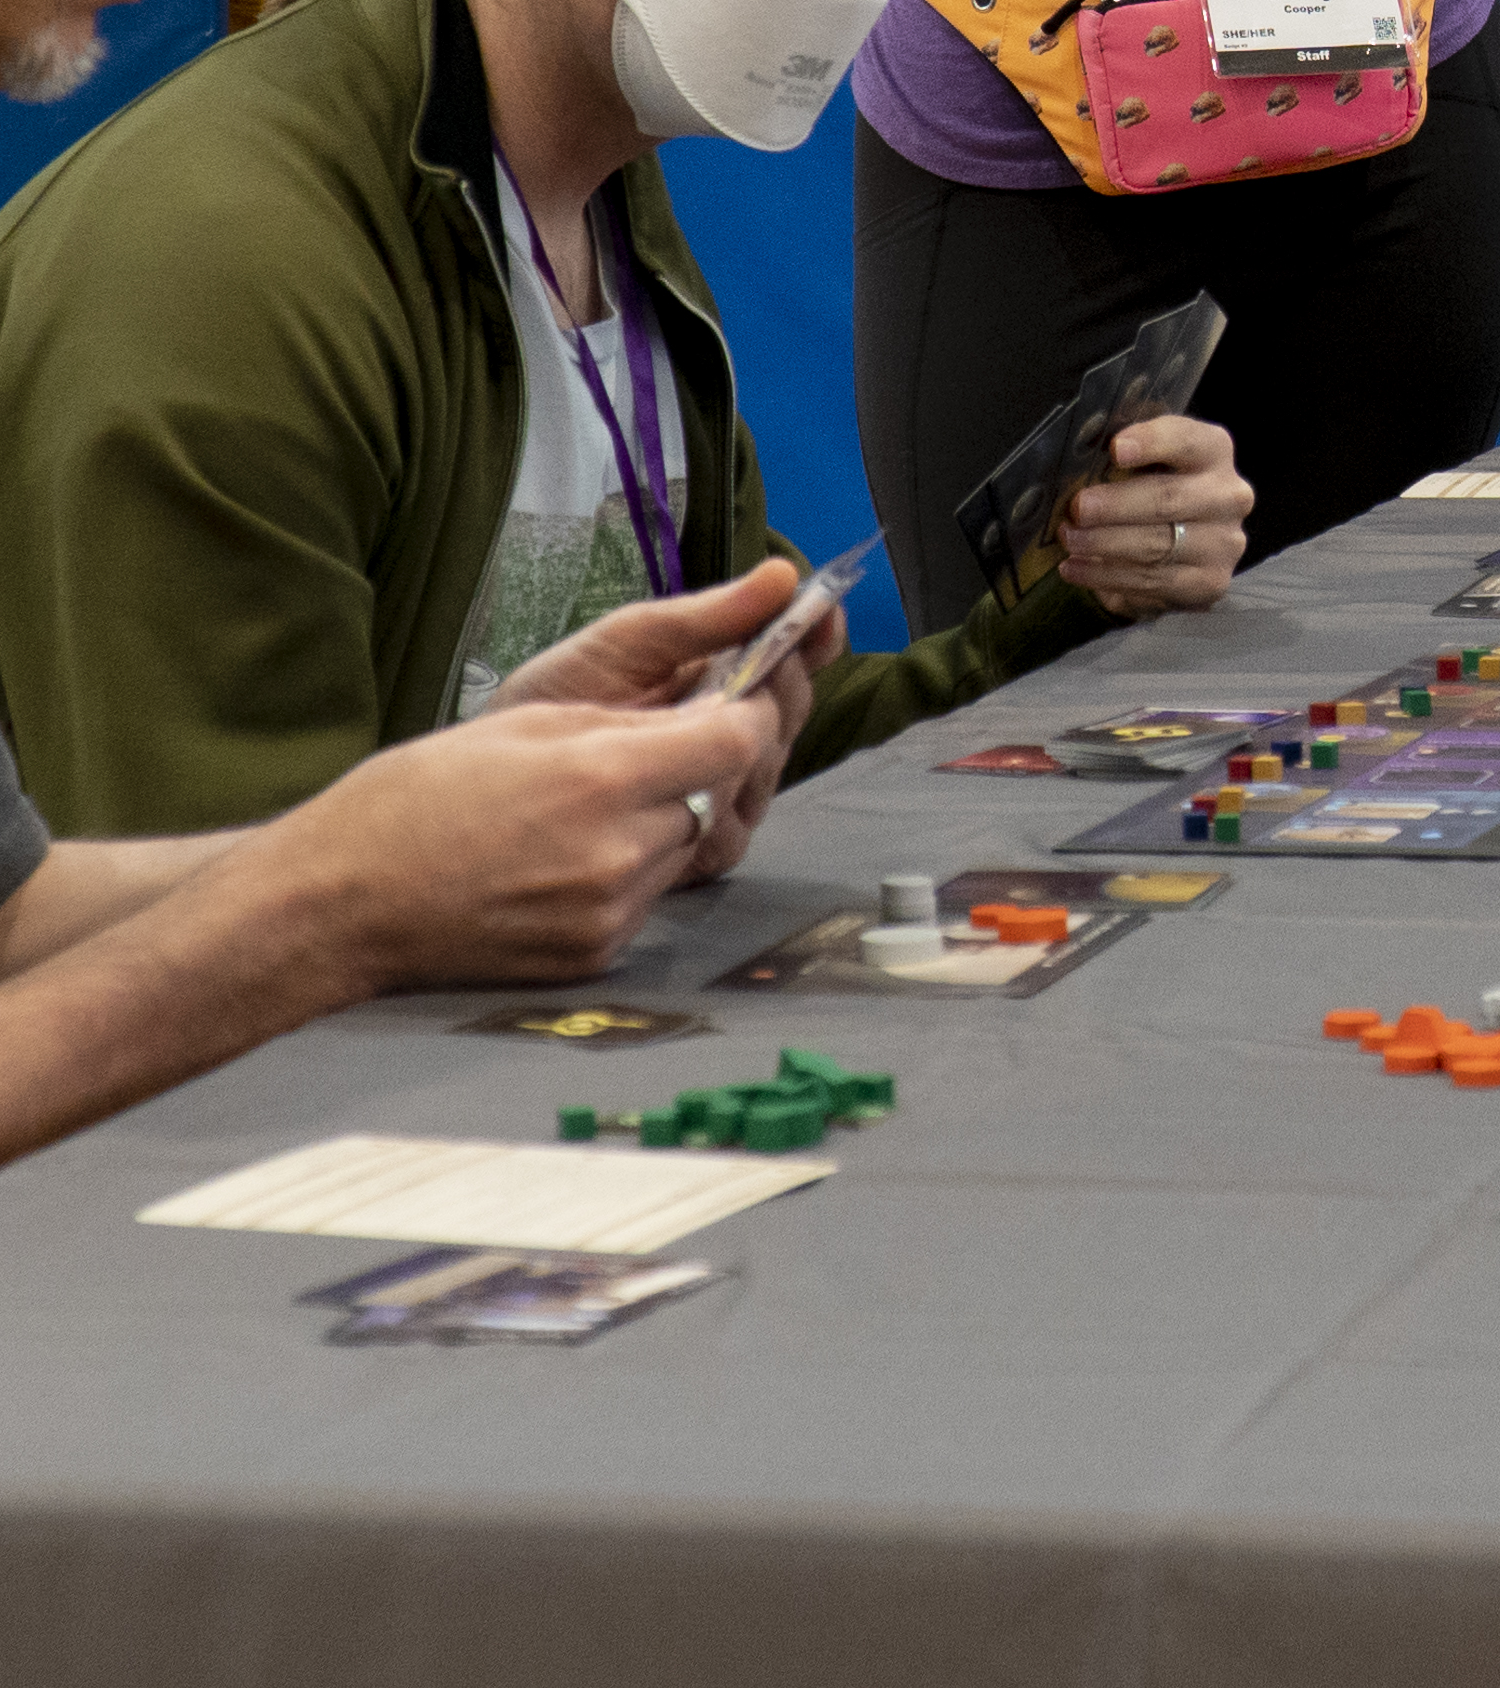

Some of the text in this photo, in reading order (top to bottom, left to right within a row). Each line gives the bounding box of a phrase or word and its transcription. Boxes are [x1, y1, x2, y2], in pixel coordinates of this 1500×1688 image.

[1284, 4, 1326, 14] Cooper
[1222, 28, 1276, 39] SHE/HER
[1296, 50, 1330, 61] Staff
